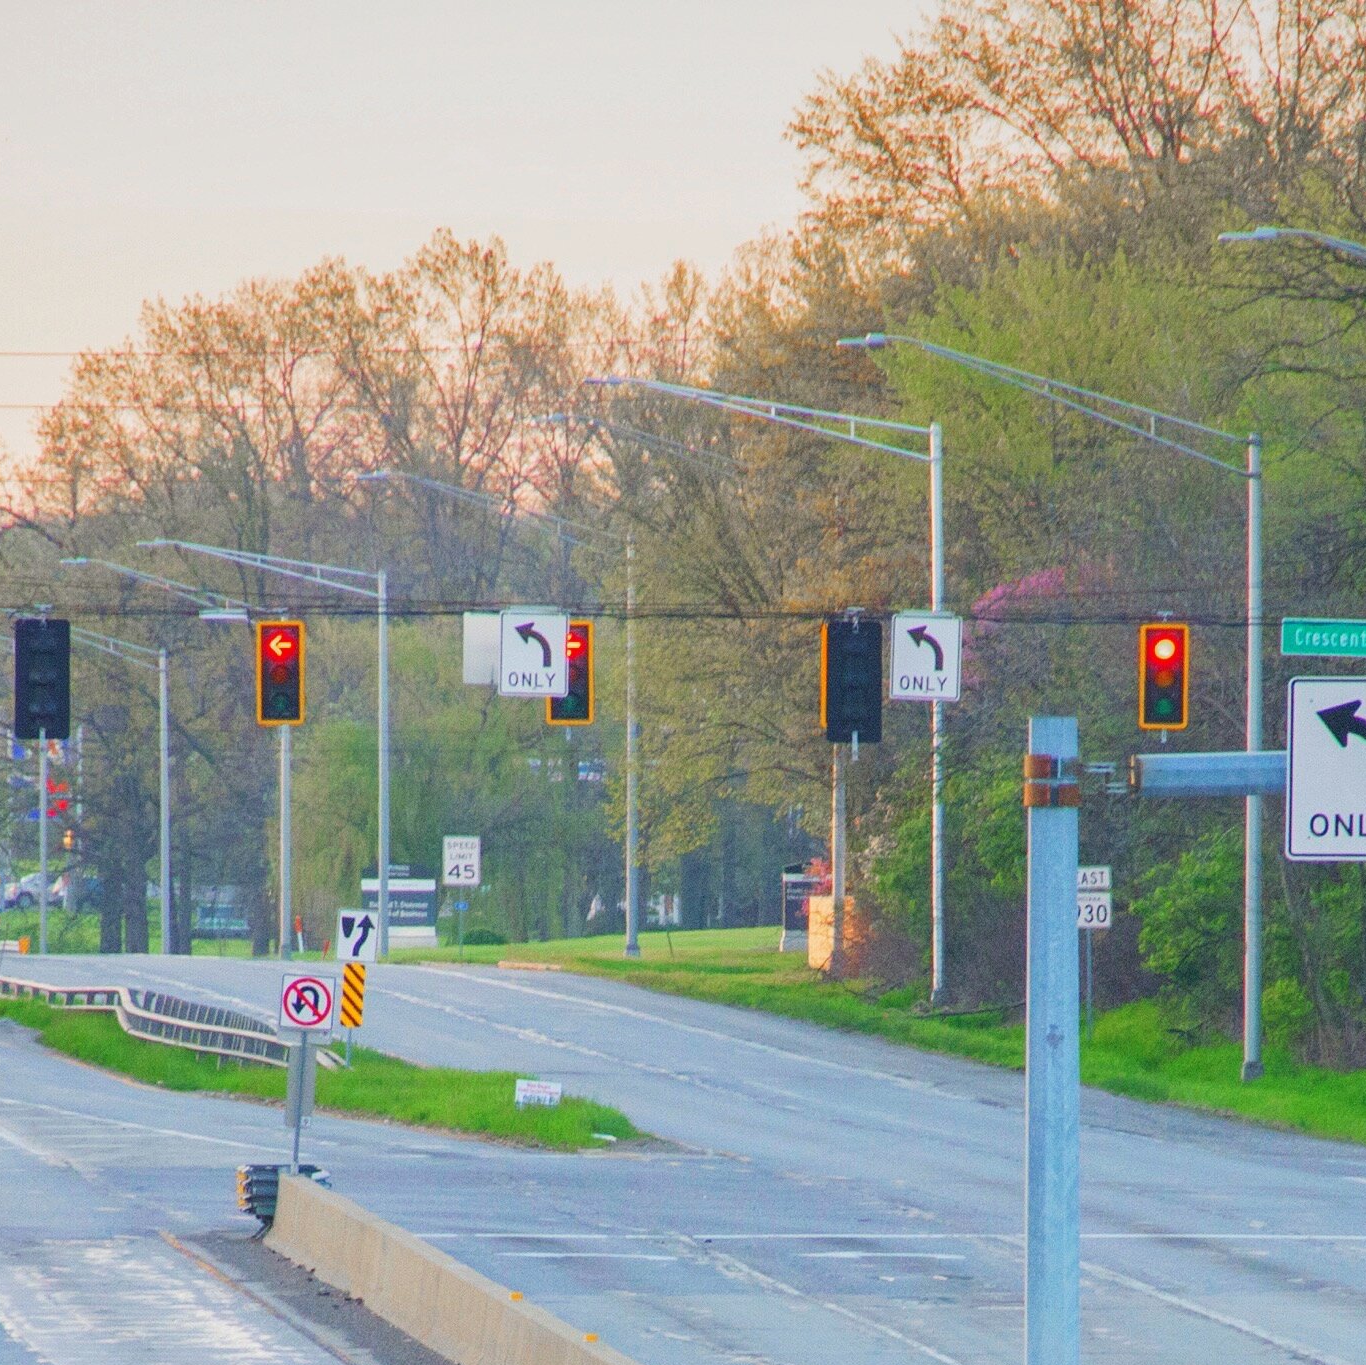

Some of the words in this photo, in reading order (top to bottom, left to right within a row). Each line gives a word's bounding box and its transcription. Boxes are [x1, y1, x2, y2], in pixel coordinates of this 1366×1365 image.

[1294, 627, 1366, 648] Crescent
[508, 671, 557, 688] ONLY
[899, 674, 948, 692] ONLY
[447, 841, 477, 850] SPEED
[448, 863, 475, 880] 45
[1077, 870, 1105, 885] AST
